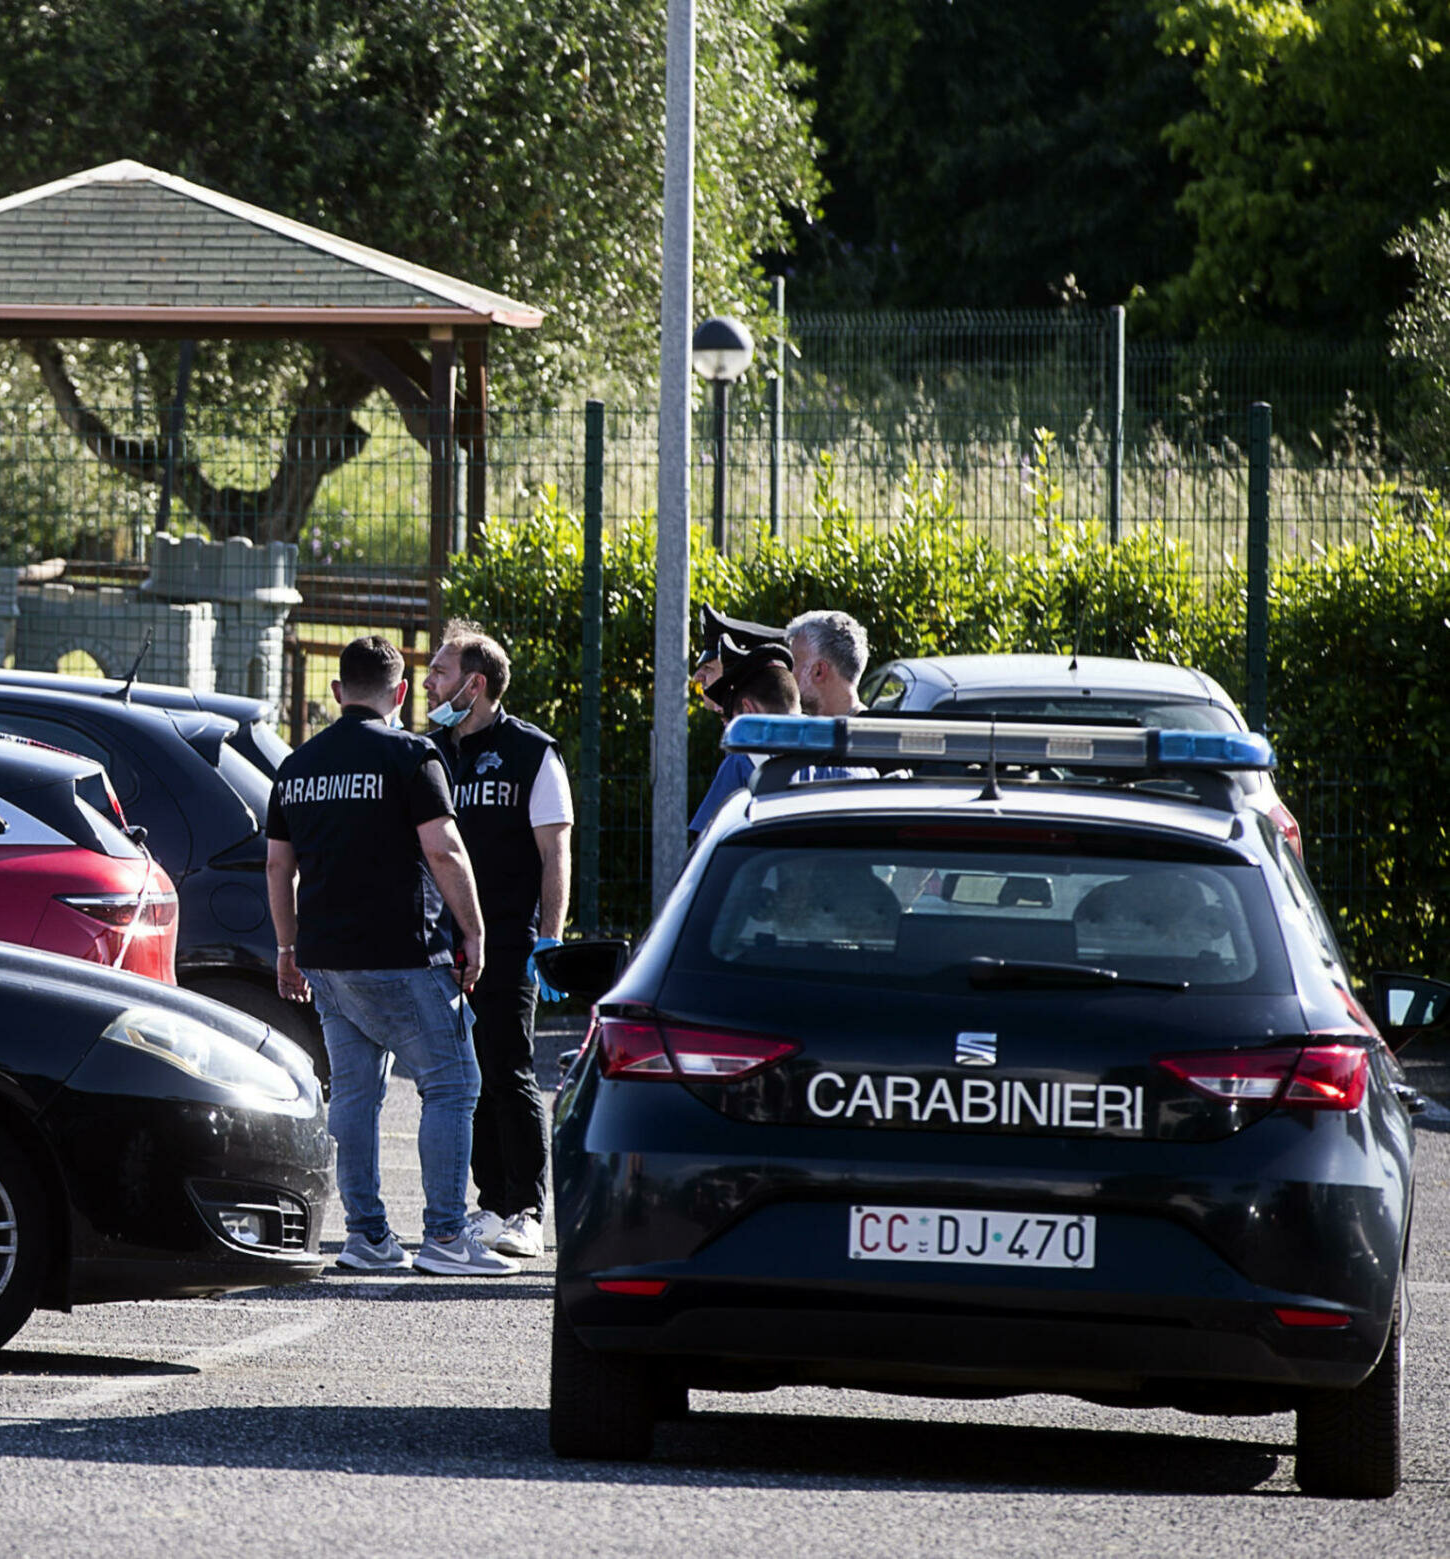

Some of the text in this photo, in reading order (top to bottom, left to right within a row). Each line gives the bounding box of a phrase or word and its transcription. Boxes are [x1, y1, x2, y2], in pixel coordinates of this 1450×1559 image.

[278, 773, 383, 806] CARABINIERI
[453, 781, 519, 808] INIERI
[807, 1072, 1143, 1130] CARABINIERI
[860, 1213, 1085, 1262] CC DJ 470
